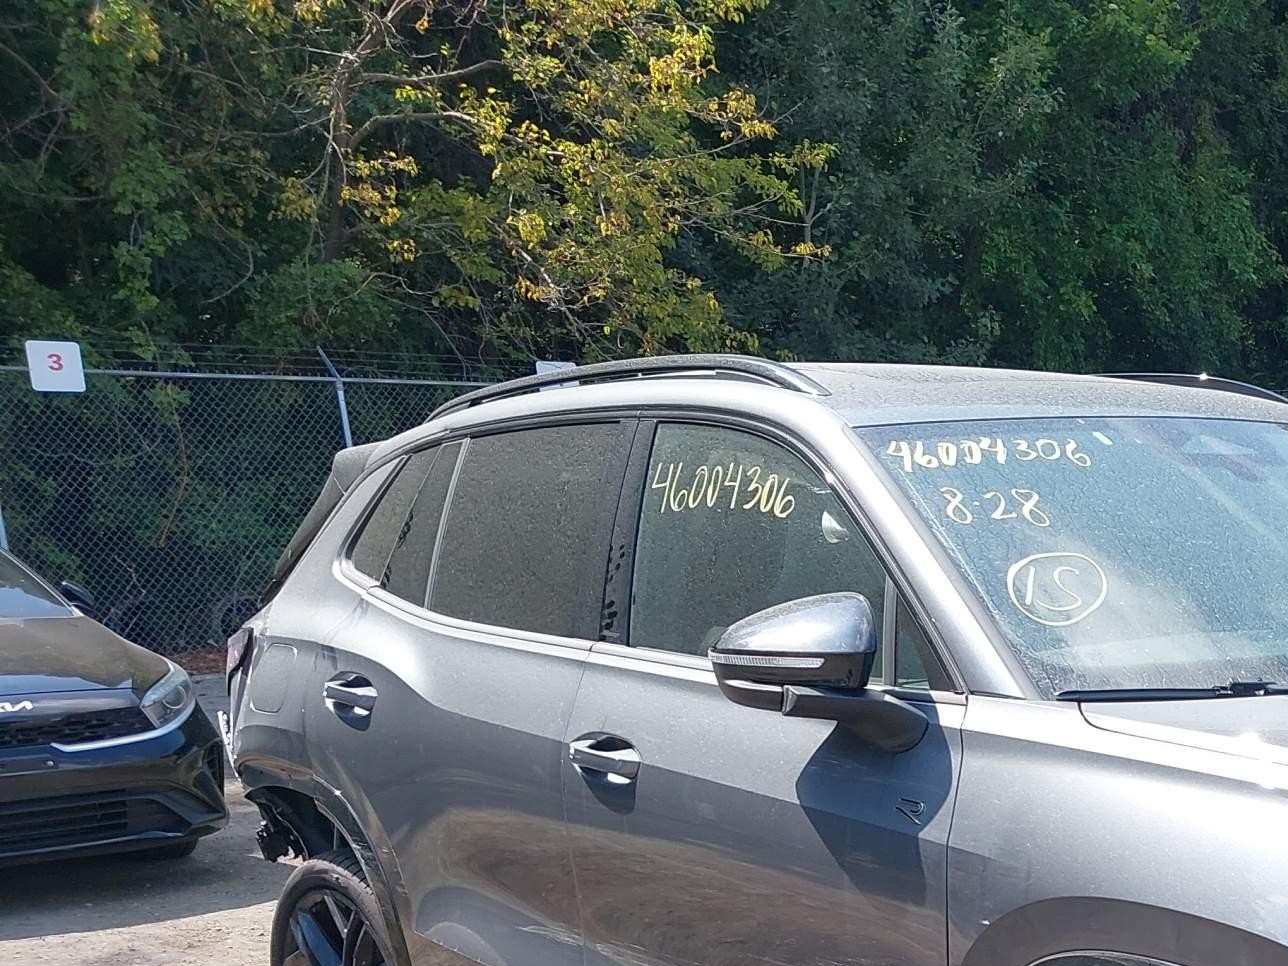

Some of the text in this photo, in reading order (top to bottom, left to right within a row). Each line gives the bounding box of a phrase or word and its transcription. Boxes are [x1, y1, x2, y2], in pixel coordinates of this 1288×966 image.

[47, 353, 64, 371] 3
[886, 434, 1092, 472] 46004306
[652, 462, 796, 518] 46004306
